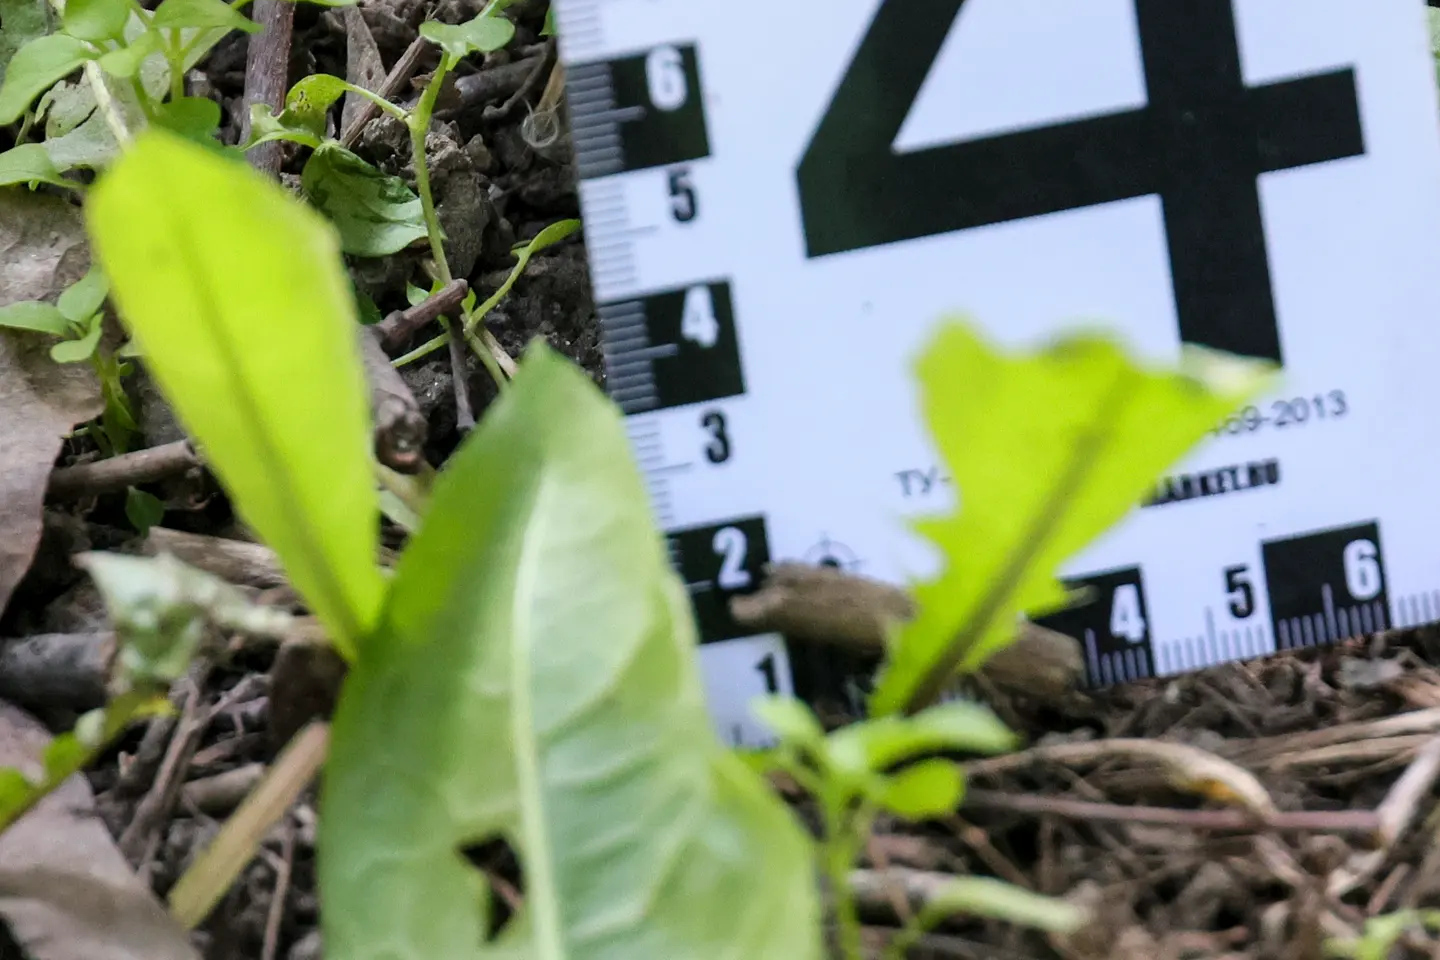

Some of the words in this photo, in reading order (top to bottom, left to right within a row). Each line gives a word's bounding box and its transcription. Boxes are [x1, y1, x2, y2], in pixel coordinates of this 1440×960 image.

[645, 45, 688, 111] 6
[667, 167, 698, 223] 5
[680, 284, 720, 348] 4
[700, 410, 732, 465] 3
[712, 526, 751, 589] 2
[1109, 583, 1146, 641] 4
[1223, 564, 1255, 619] 5
[1343, 538, 1380, 601] 6
[756, 652, 778, 695] 1
